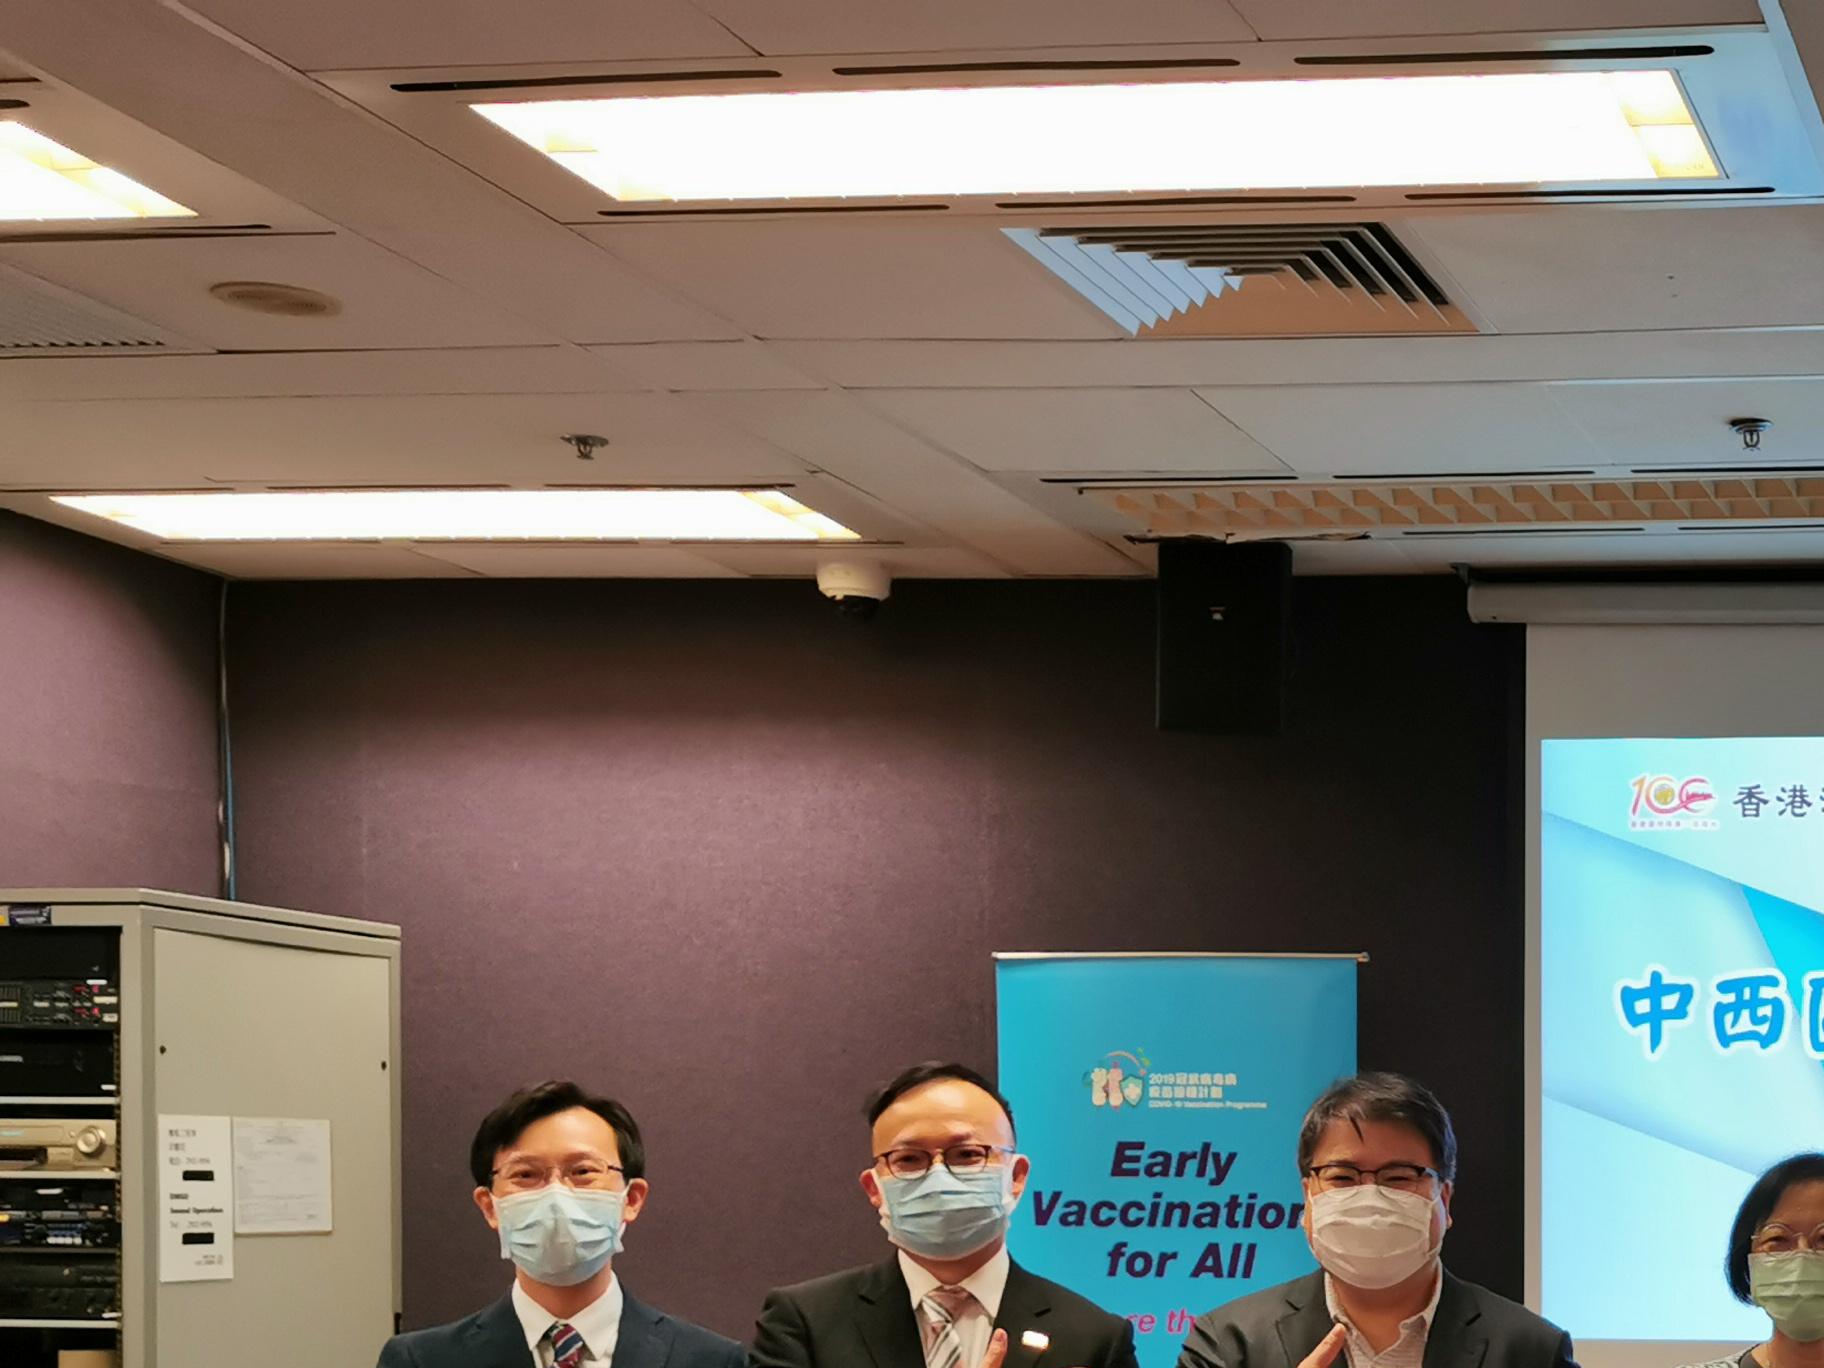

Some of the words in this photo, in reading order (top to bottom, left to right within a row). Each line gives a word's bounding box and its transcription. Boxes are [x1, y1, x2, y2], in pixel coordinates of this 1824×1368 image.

[1110, 1141, 1238, 1186] Early
[1107, 1242, 1178, 1278] for
[1189, 1242, 1258, 1279] All
